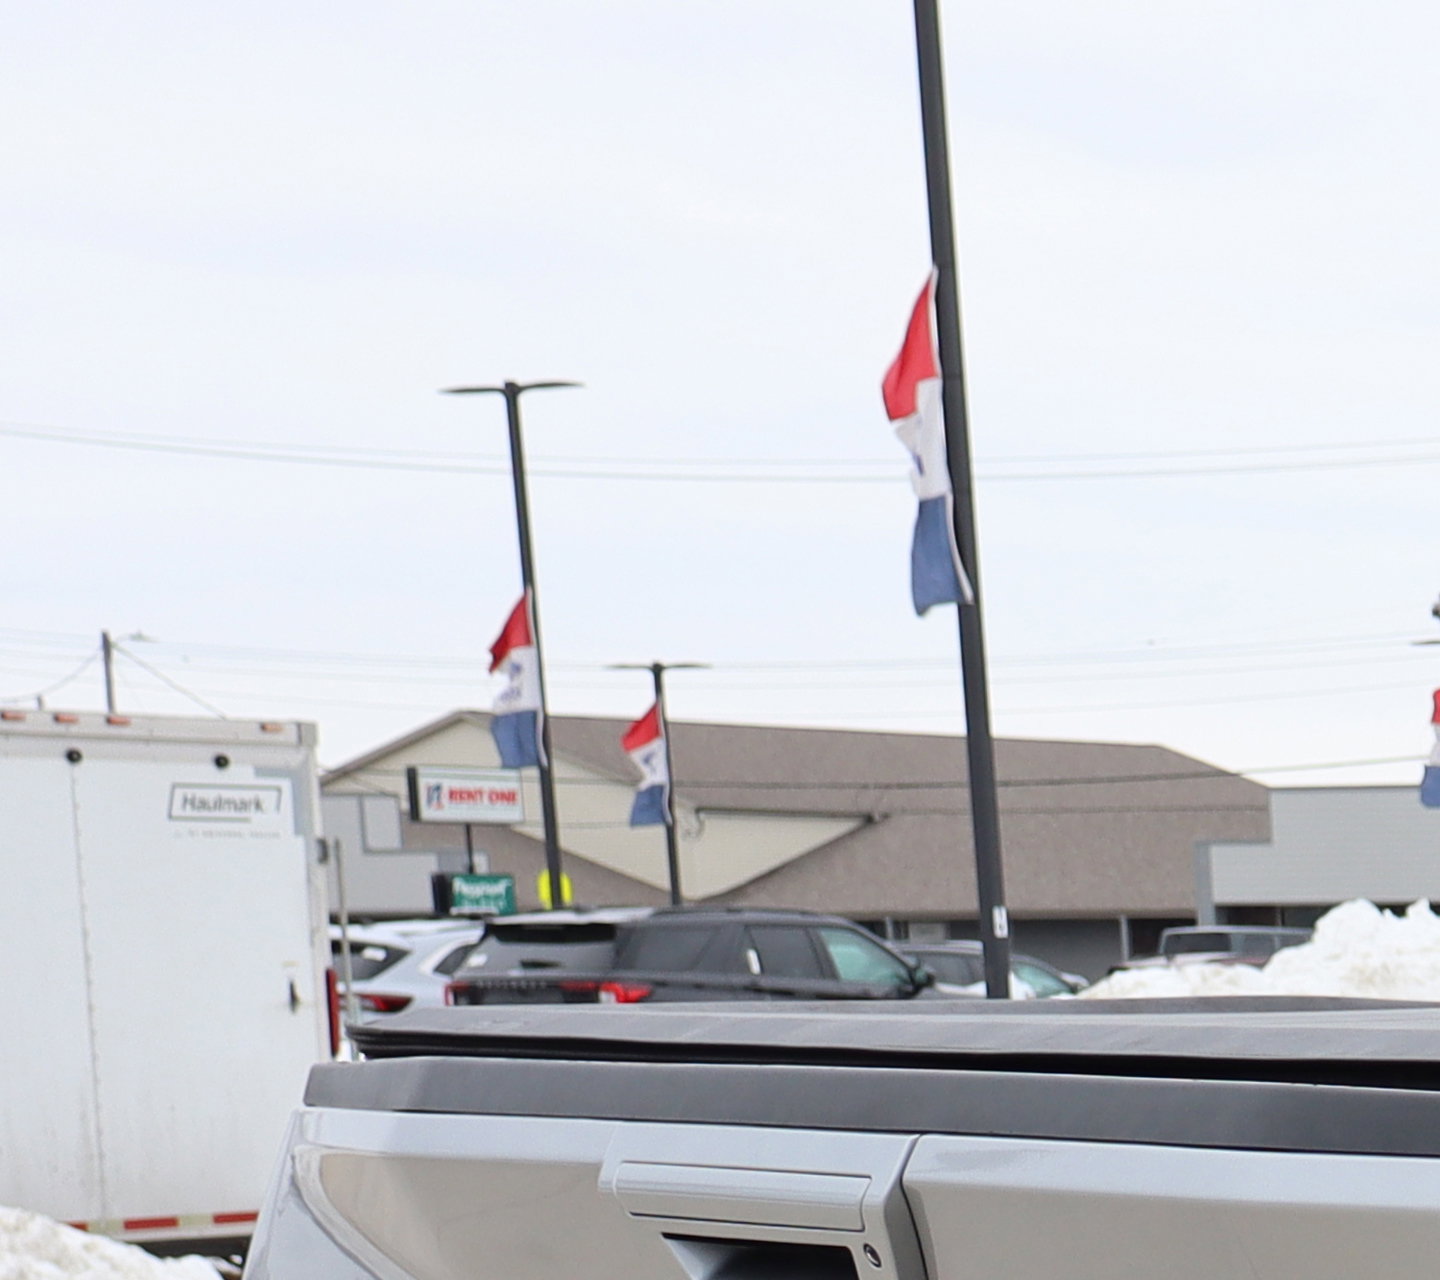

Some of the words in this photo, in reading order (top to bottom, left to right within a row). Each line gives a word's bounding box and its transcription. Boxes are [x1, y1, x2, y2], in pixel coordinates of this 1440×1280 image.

[181, 791, 265, 813] Haulmark
[448, 788, 484, 803] RENT
[488, 789, 517, 805] ONE
